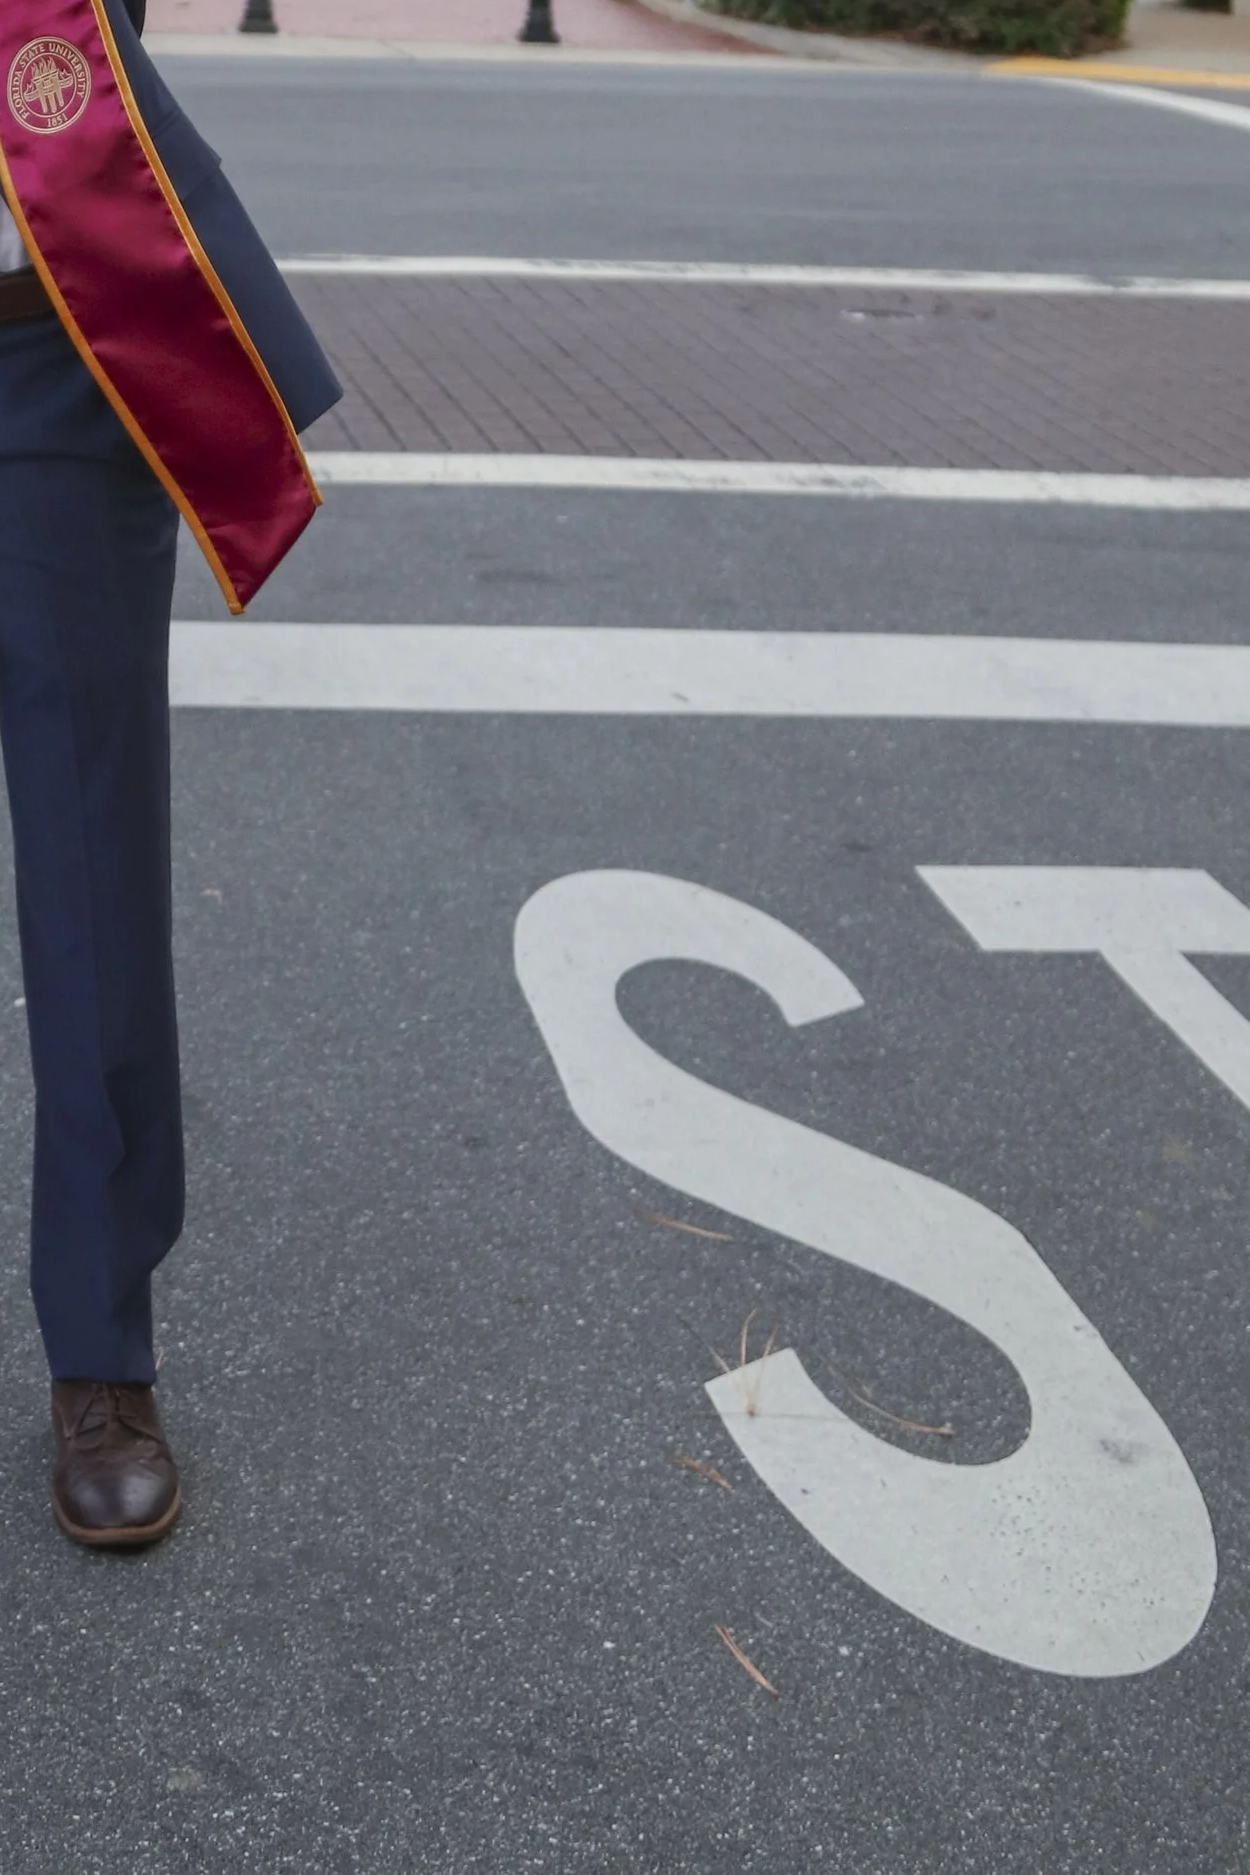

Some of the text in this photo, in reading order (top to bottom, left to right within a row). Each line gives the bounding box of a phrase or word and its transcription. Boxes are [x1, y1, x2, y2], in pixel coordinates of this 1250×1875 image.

[12, 43, 86, 120] FLORIDA STATE UNIVERSITY
[47, 113, 68, 128] 1851
